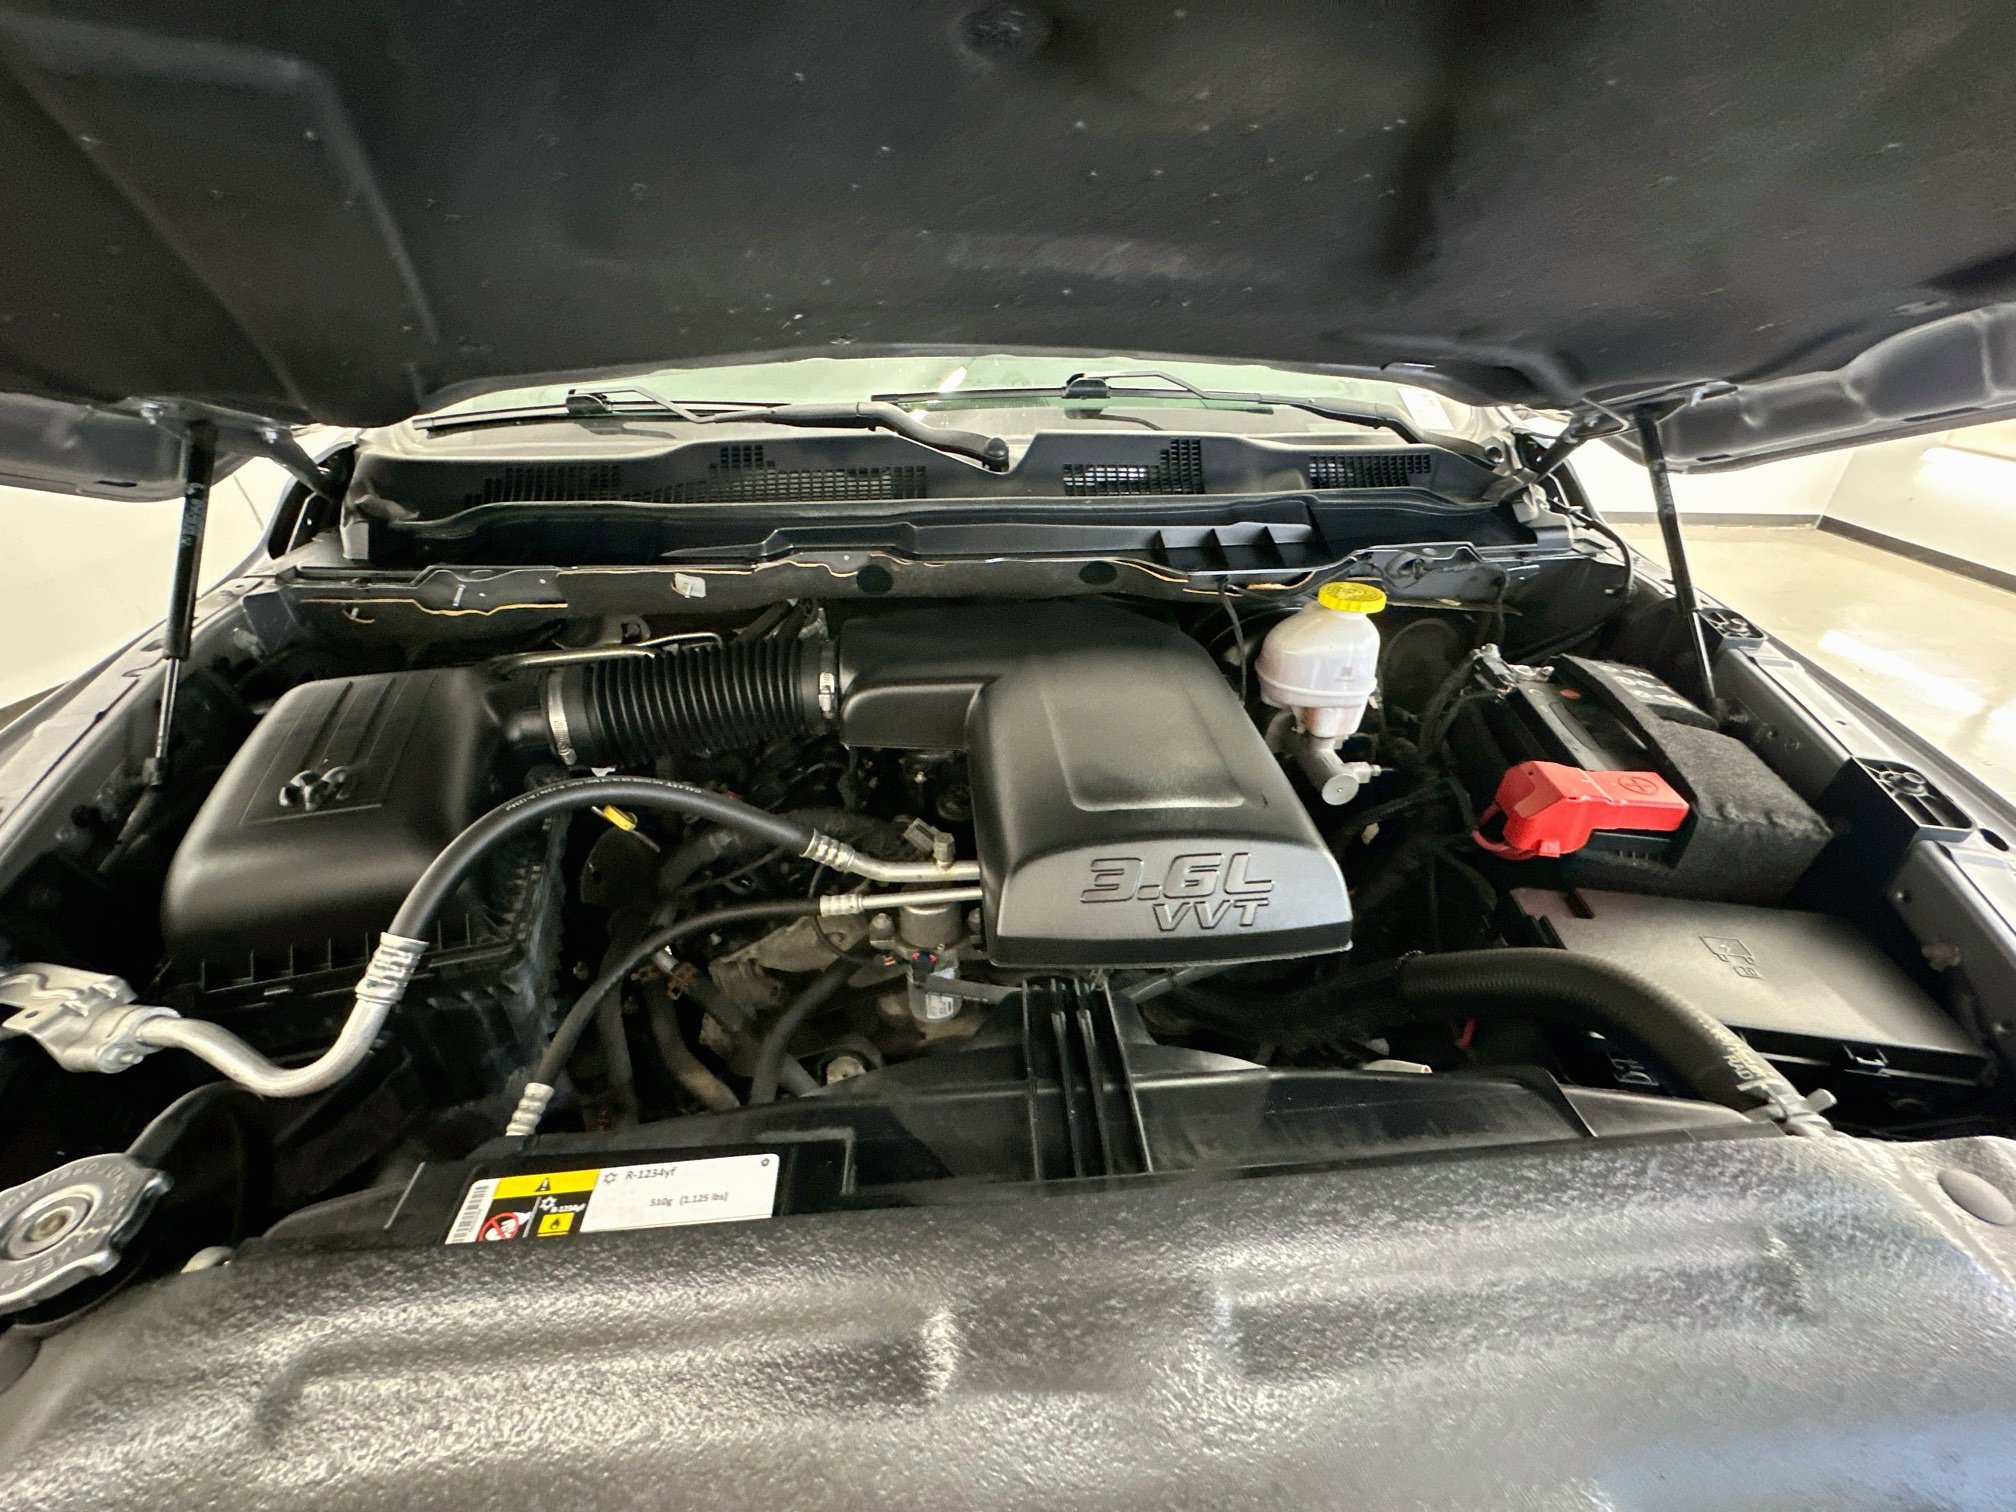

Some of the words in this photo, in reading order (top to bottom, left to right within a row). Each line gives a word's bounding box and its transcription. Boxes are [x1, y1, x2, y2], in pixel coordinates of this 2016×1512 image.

[1080, 851, 1276, 904] 3.6L
[1152, 897, 1271, 932] VVT
[625, 1167, 677, 1180] R-1234yf
[679, 1194, 709, 1206] (1.125
[711, 1191, 728, 1202] lbs)
